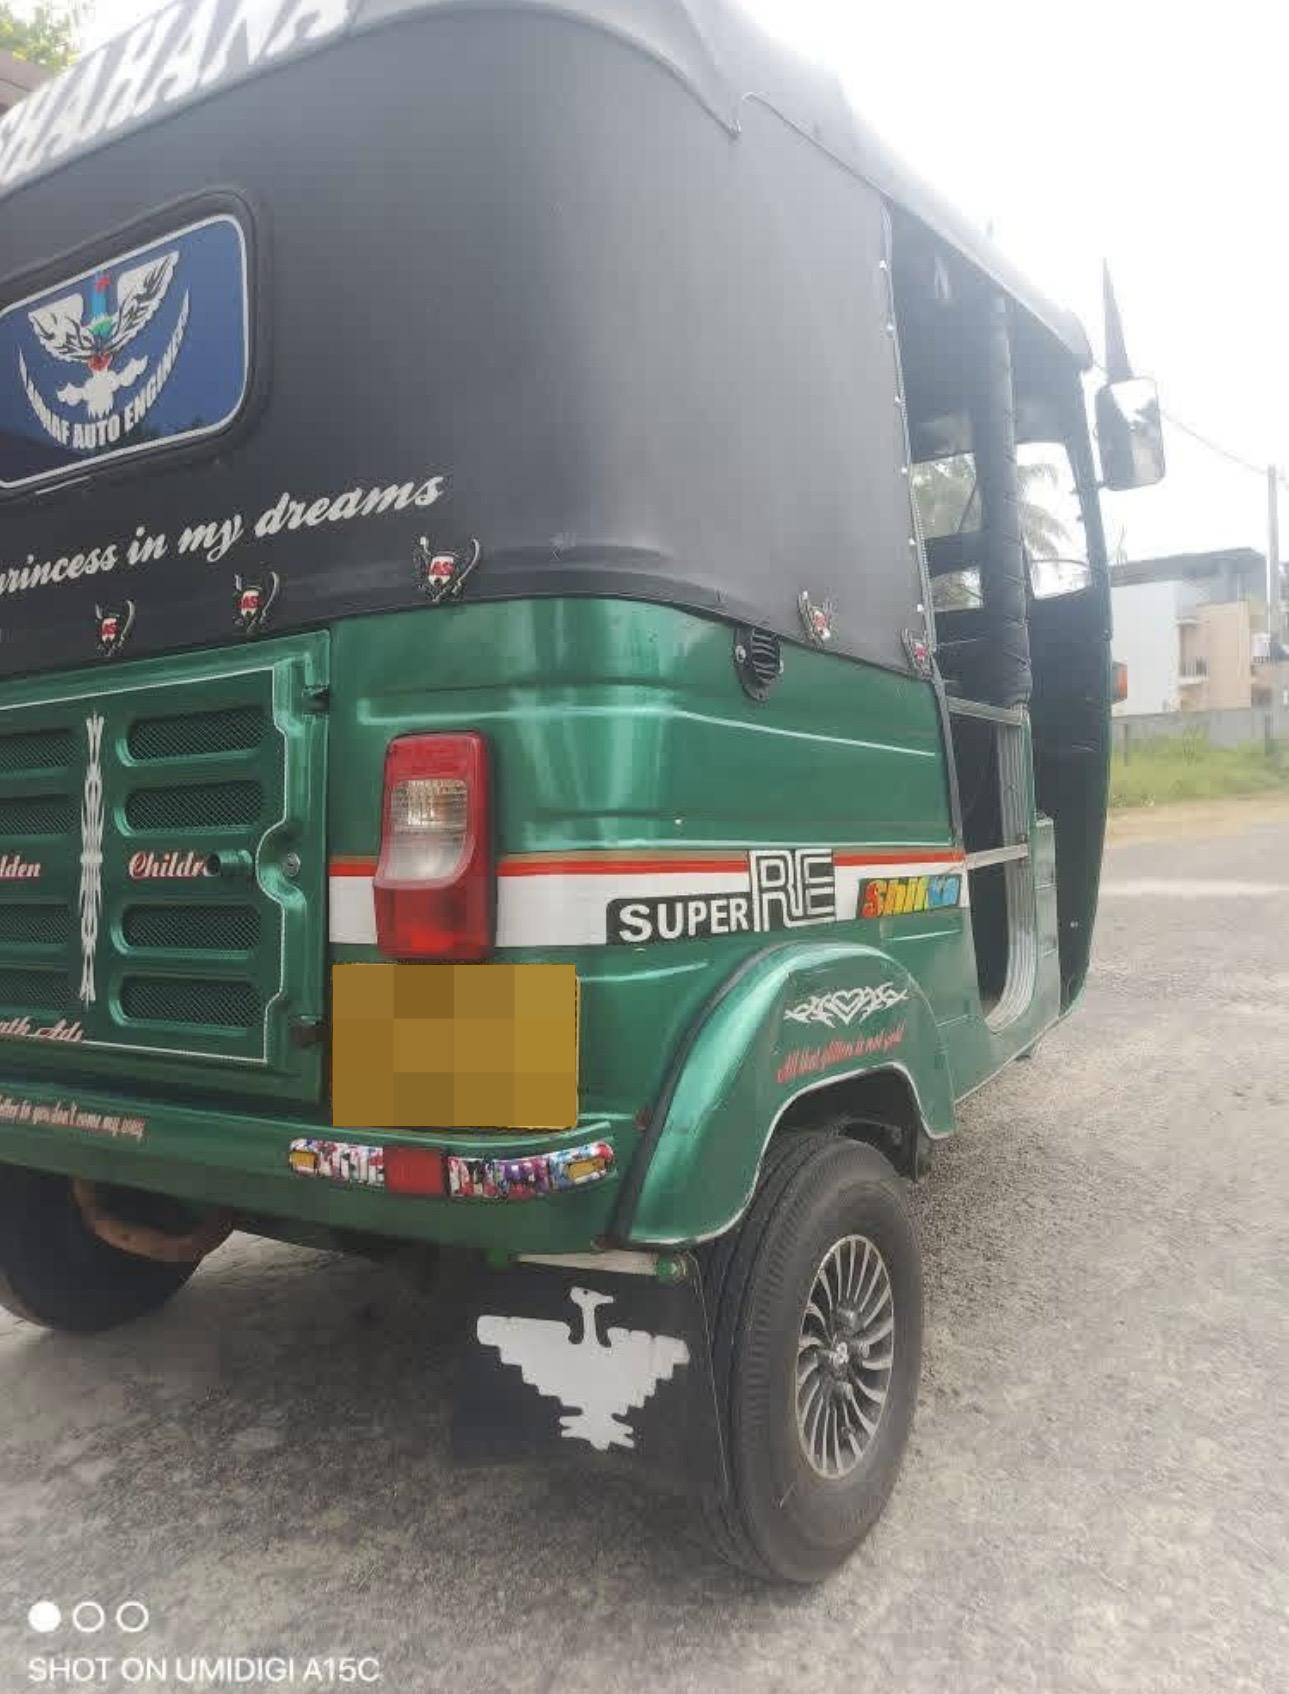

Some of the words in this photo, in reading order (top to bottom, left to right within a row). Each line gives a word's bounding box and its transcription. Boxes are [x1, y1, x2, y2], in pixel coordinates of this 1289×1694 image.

[72, 413, 121, 450] AUTO
[126, 526, 168, 566] in
[178, 513, 244, 563] my
[255, 475, 446, 539] dreams
[0, 854, 41, 879] lden
[618, 897, 749, 944] SUPER
[749, 848, 835, 932] RE
